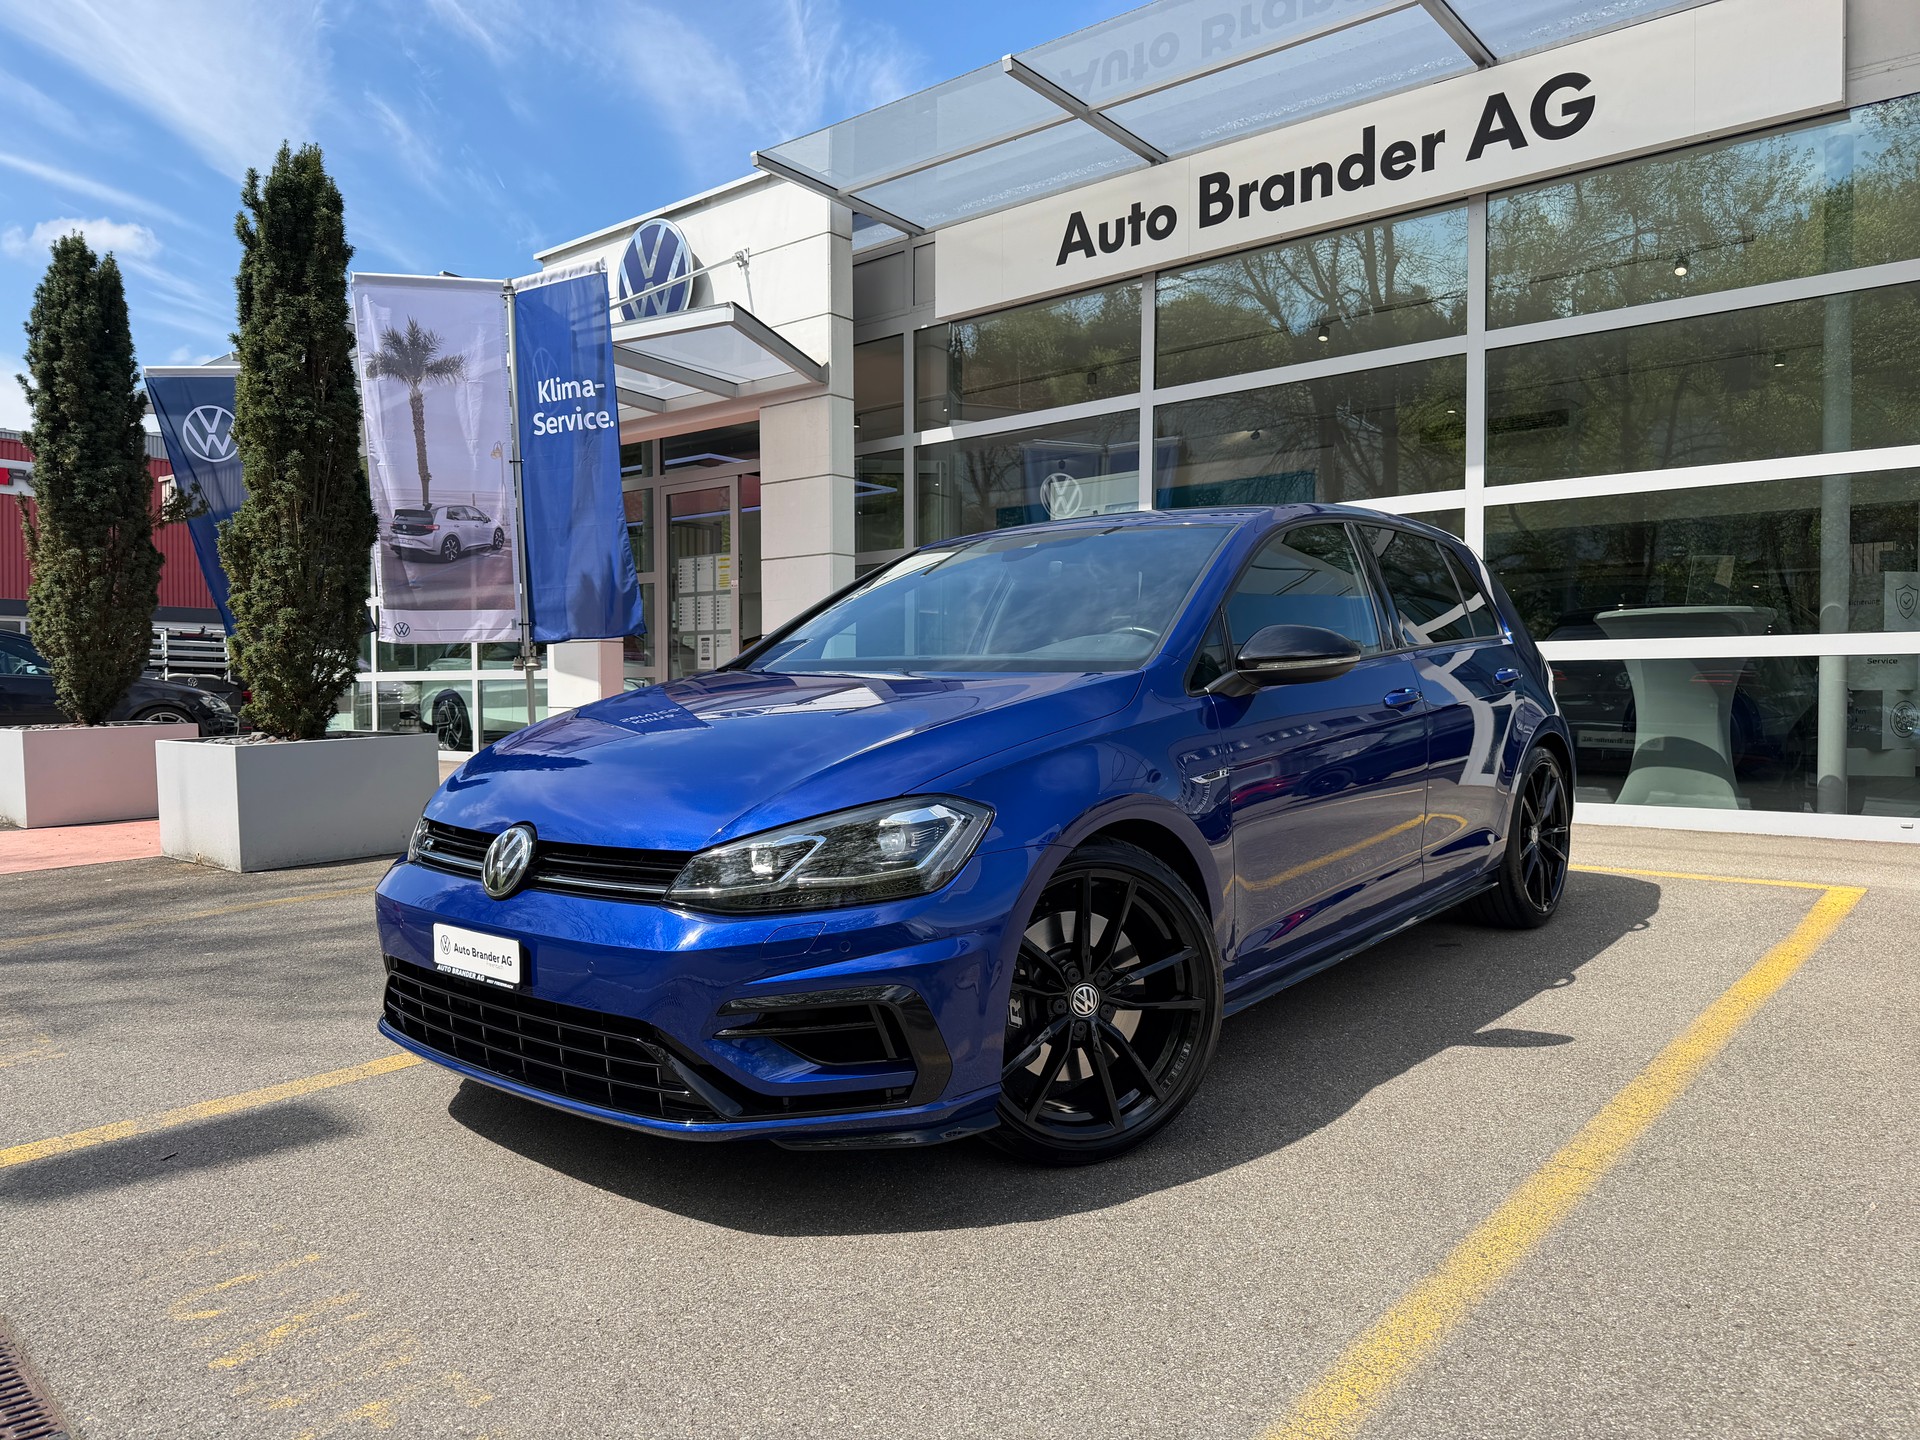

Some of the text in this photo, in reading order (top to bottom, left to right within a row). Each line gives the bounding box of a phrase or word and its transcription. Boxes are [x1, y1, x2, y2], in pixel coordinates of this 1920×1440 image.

[1055, 71, 1596, 266] Auto Brander AG
[537, 376, 606, 404] Klima-
[533, 406, 615, 436] Service.
[1866, 657, 1899, 666] Service
[453, 942, 471, 956] Auto
[471, 947, 500, 963] Brander
[501, 954, 513, 967] AG
[436, 963, 485, 982] AUTO BRANDER AG
